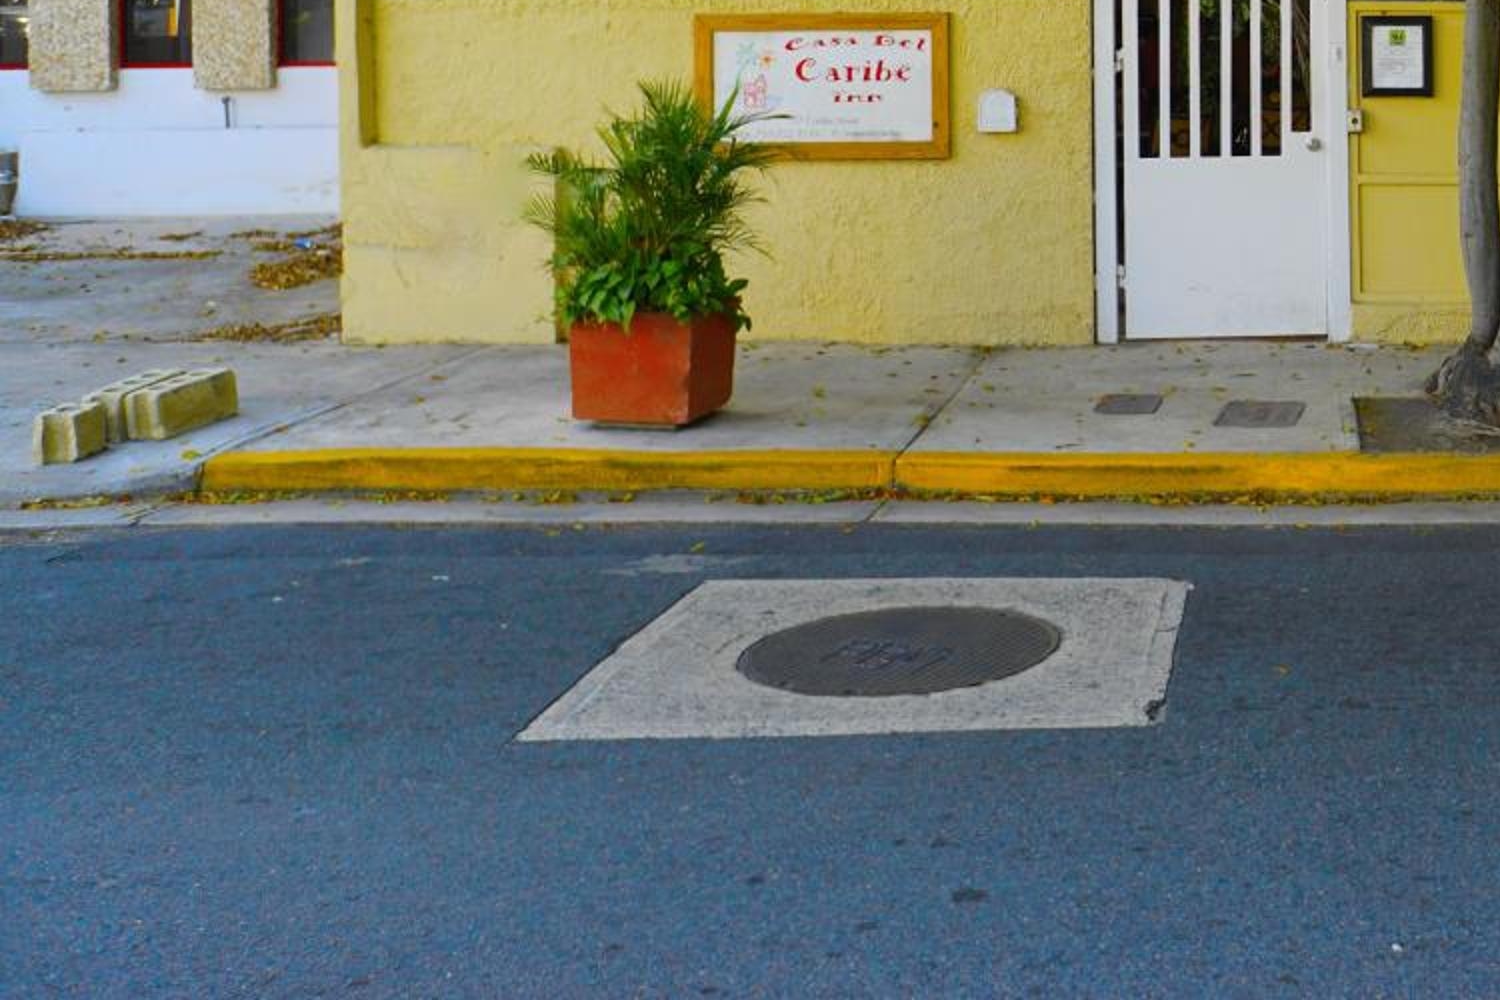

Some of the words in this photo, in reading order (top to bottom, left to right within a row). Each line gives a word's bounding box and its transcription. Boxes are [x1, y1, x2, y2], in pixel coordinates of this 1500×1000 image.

[785, 36, 858, 52] Casa
[875, 34, 925, 51] Del
[795, 57, 911, 82] Caribe
